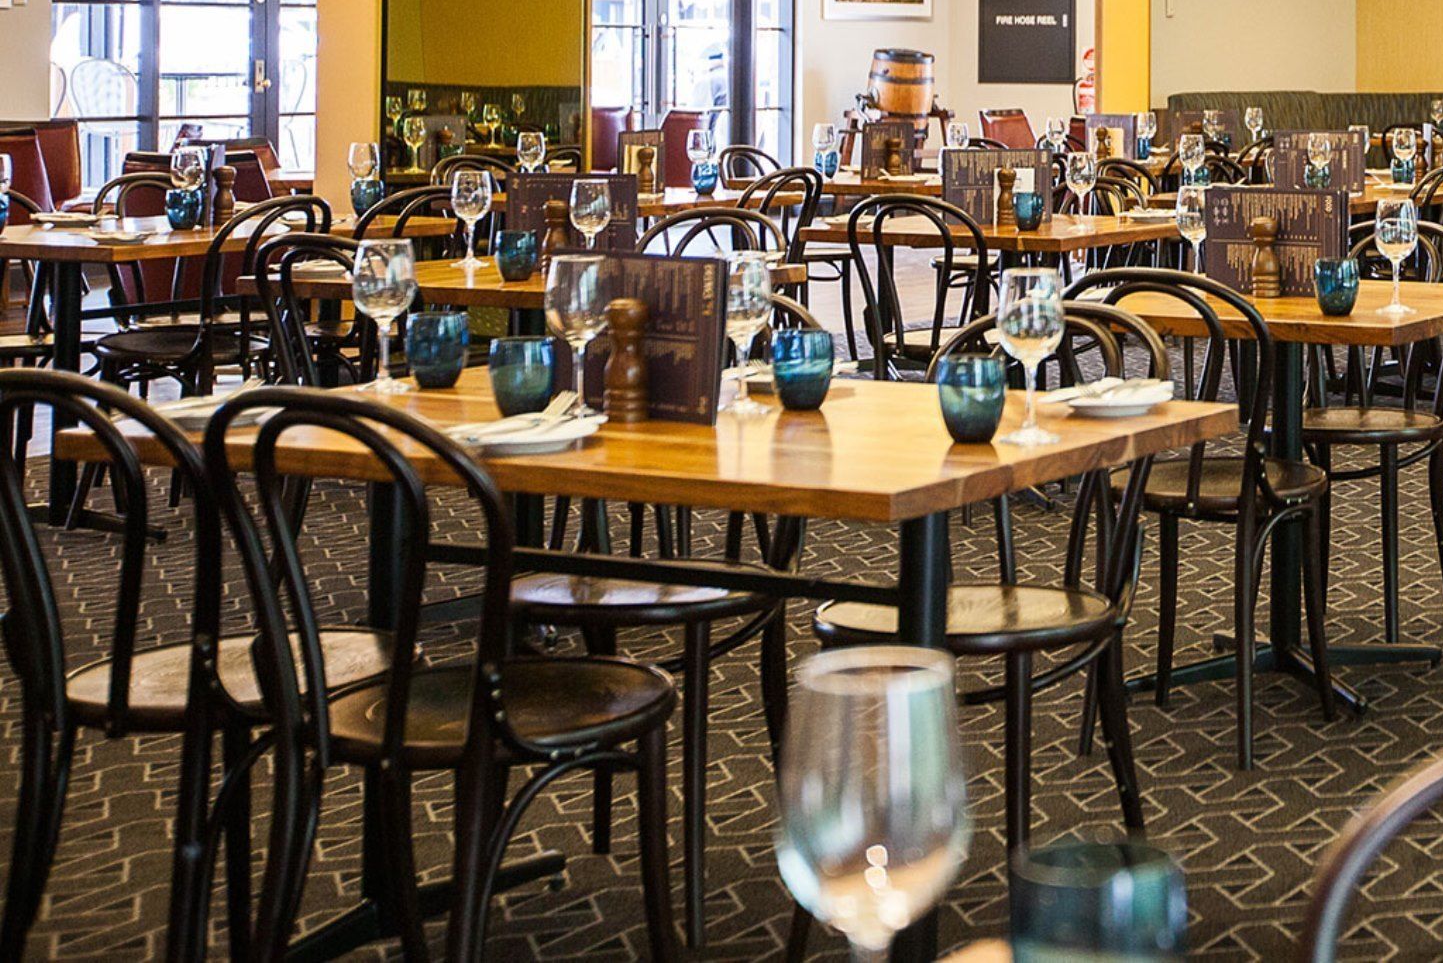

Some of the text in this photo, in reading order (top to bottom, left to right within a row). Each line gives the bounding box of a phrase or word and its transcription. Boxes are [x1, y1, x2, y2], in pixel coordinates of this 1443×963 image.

[996, 15, 1057, 26] FIRE HOSE REEL
